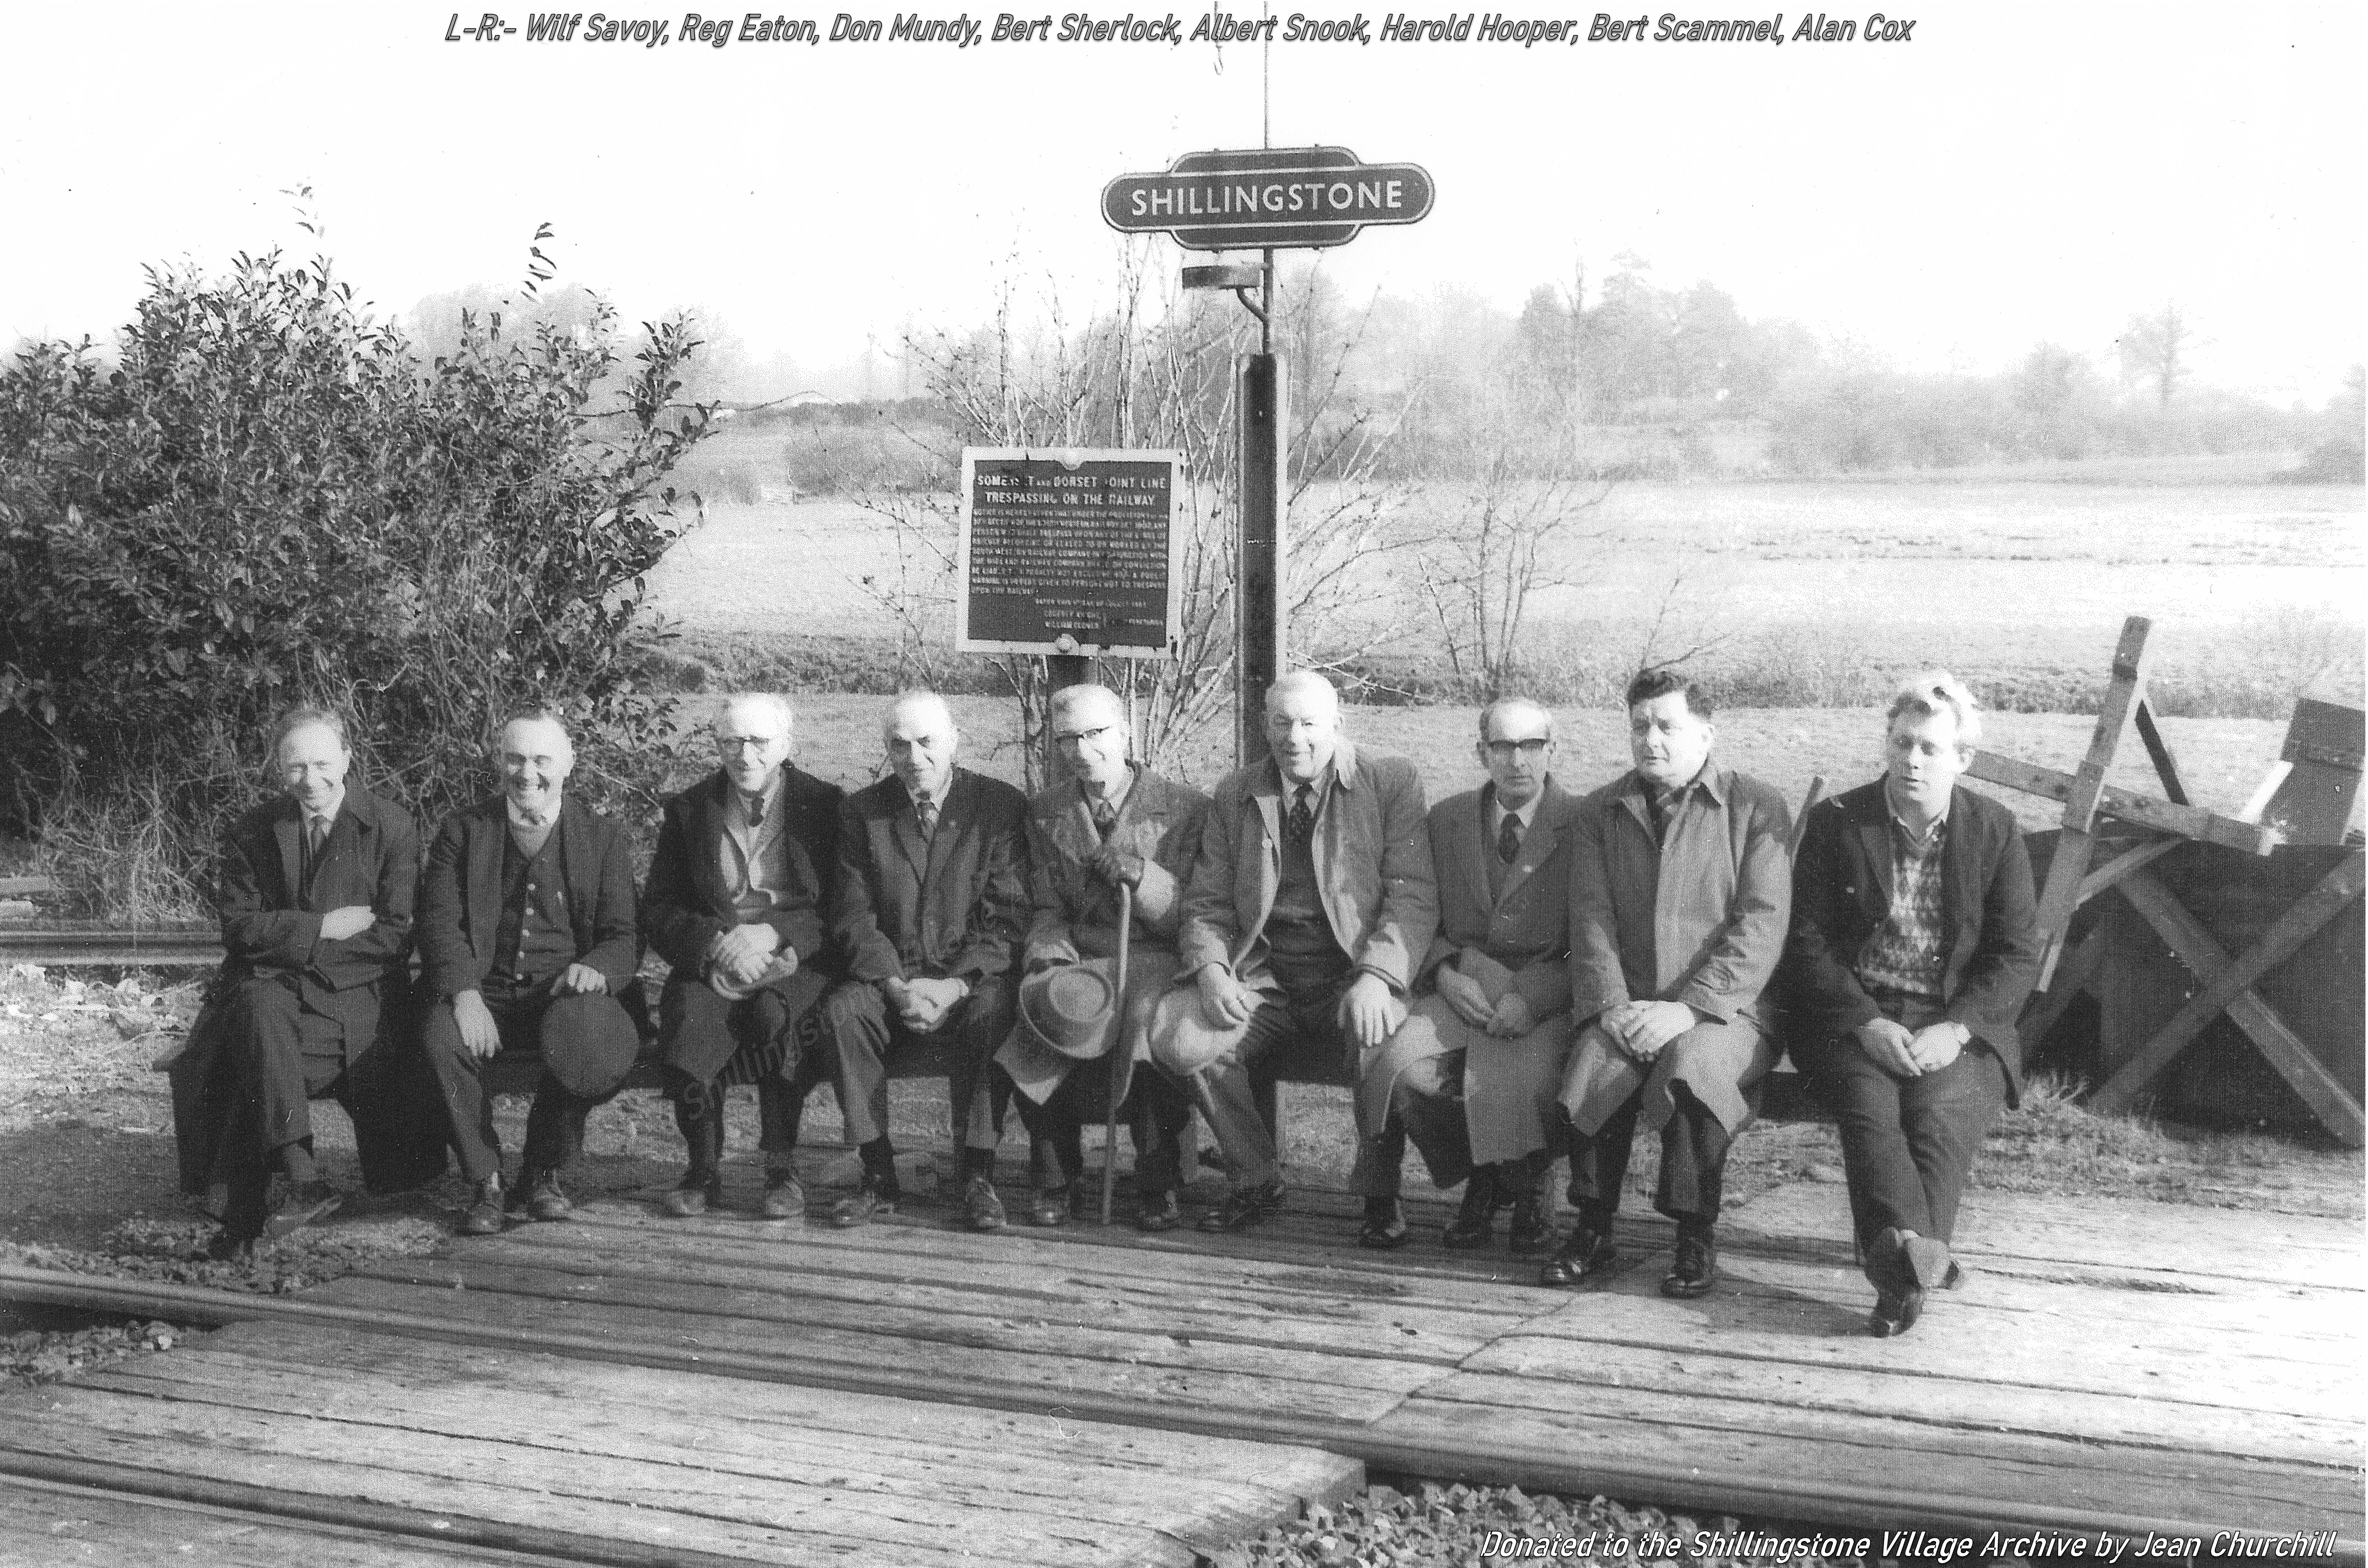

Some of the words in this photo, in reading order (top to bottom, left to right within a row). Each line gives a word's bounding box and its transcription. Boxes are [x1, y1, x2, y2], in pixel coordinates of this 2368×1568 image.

[1132, 180, 1402, 216] SHILLINGSTONE
[1053, 476, 1098, 487] DORSET
[1105, 477, 1136, 488] OINT
[1141, 477, 1166, 488] LINE
[985, 492, 1058, 504] TRESPASSING
[1063, 493, 1078, 504] ON
[1083, 494, 1103, 505] THE
[1109, 494, 1155, 505] RAILWAY
